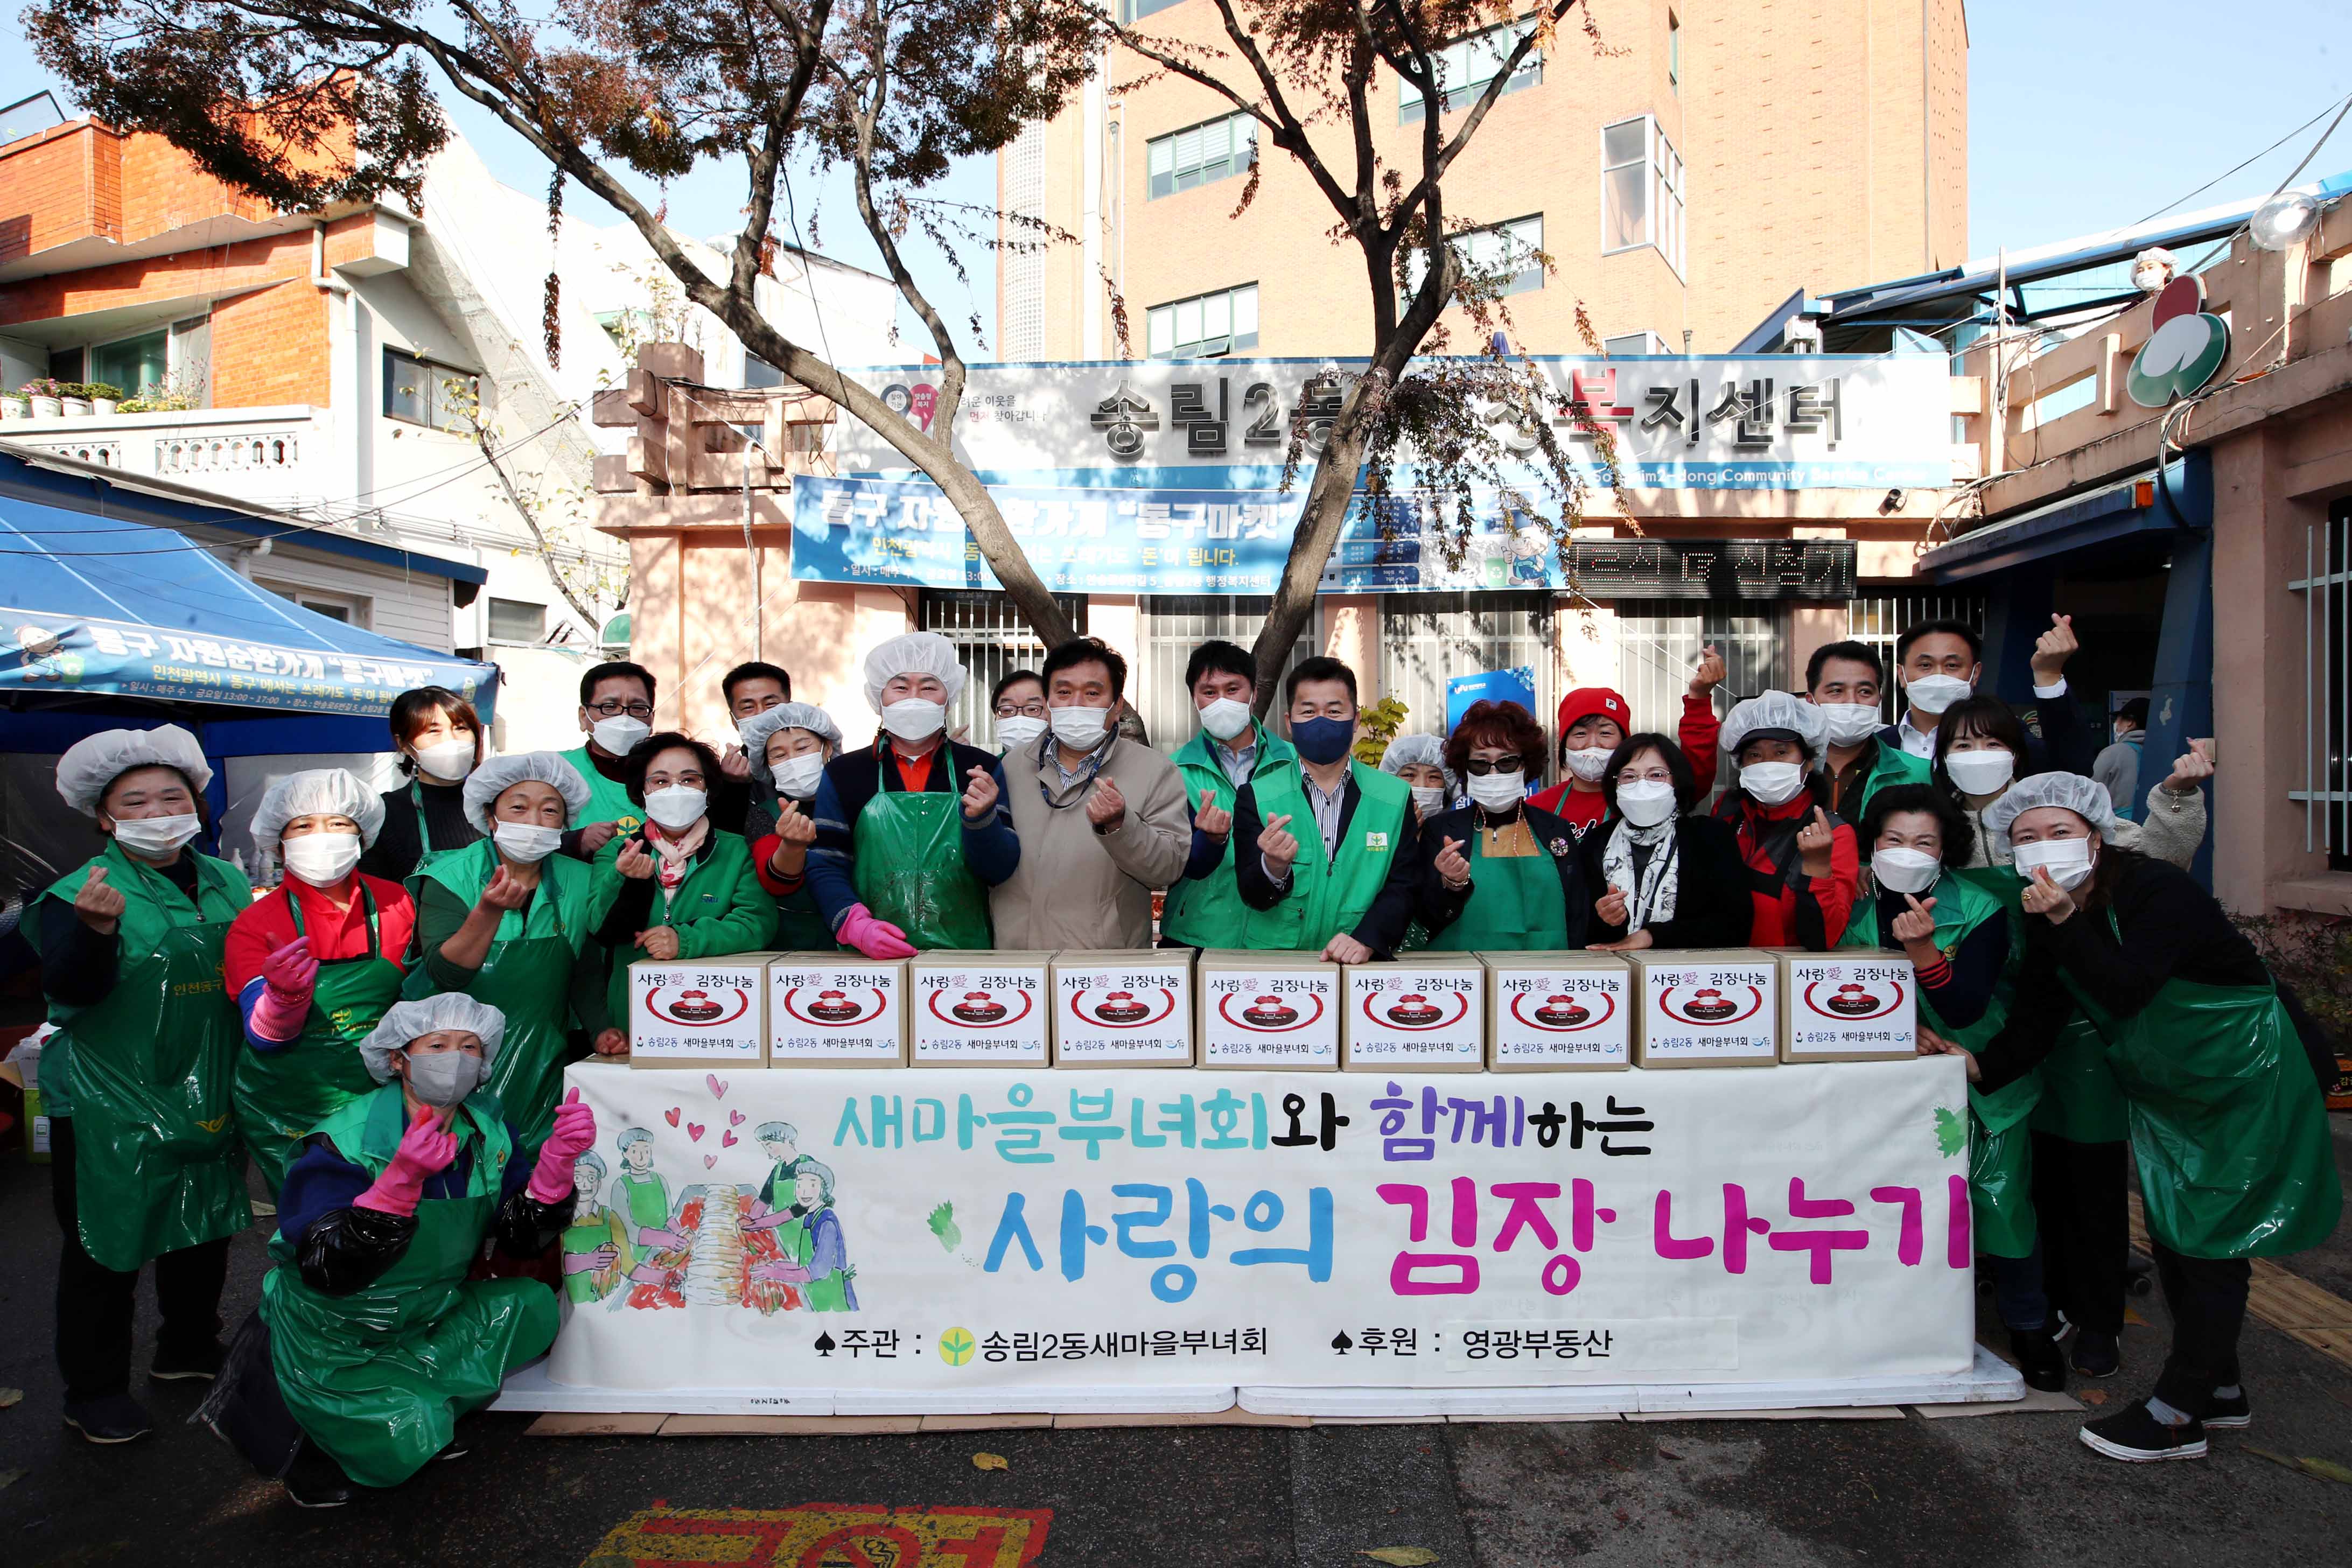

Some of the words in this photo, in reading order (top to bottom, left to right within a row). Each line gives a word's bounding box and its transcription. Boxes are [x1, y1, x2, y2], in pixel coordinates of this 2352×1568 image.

[957, 396, 981, 408] 려운
[985, 395, 1016, 407] 이웃을
[969, 412, 989, 423] 먼저
[1090, 376, 1345, 462] 송림2동
[1722, 468, 1805, 484] Community
[820, 489, 888, 528] 동구
[897, 494, 1108, 537] 자원환가게
[87, 626, 160, 658] 동구
[161, 635, 326, 680] 자원순환가게
[152, 664, 221, 686] 인천광역시
[301, 682, 345, 698] 쓰레기도
[157, 684, 175, 695] 매주
[195, 688, 223, 699] 금요일
[223, 691, 248, 701] 13:00
[255, 695, 279, 704] 17:00
[1710, 972, 1767, 987] 김장나눔
[1853, 967, 1909, 982] 김장나눔
[696, 975, 754, 989] 김장나눔
[834, 975, 891, 989] 김장나눔
[979, 976, 1037, 989] 김장나눔
[1121, 975, 1180, 989] 김장나눔
[1271, 980, 1329, 993] 김장나눔
[1415, 978, 1473, 992] 김장나눔
[1562, 979, 1620, 992] 김장나눔
[648, 1037, 678, 1047] 송림2동
[683, 1038, 733, 1048] 새마을부녀회
[788, 1038, 817, 1048] 송림2동
[823, 1038, 872, 1048] 새마을부녀회
[1663, 1038, 1692, 1048] 송림2동
[1698, 1036, 1747, 1047] 새마을부녀회
[1807, 1032, 1837, 1042] 송림2동
[1842, 1031, 1890, 1042] 새마을부녀회
[932, 1040, 962, 1049] 송림2동
[967, 1039, 1017, 1049] 새마을부녀회
[1076, 1040, 1105, 1051] 송림2동
[1111, 1039, 1161, 1049] 새마을부녀회
[1222, 1044, 1252, 1054] 송림2동
[1258, 1044, 1308, 1054] 새마을부녀회
[1366, 1042, 1397, 1053] 송림2동
[1402, 1042, 1453, 1052] 새마을부녀회
[1514, 1044, 1544, 1053] 송림2동
[1549, 1043, 1600, 1053] 새마을부녀회
[833, 1082, 1350, 1164] 새마을부녀회와
[1369, 1080, 1654, 1161] 함께하는
[983, 1178, 1334, 1303] 사랑의
[1376, 1176, 1617, 1295] 김장
[1654, 1174, 1971, 1285] 나누기
[841, 1329, 900, 1359] 주관
[981, 1327, 1269, 1363] 송림2동새마을부녀회
[1357, 1328, 1418, 1357] 후원
[1462, 1328, 1614, 1360] 영광부동산
